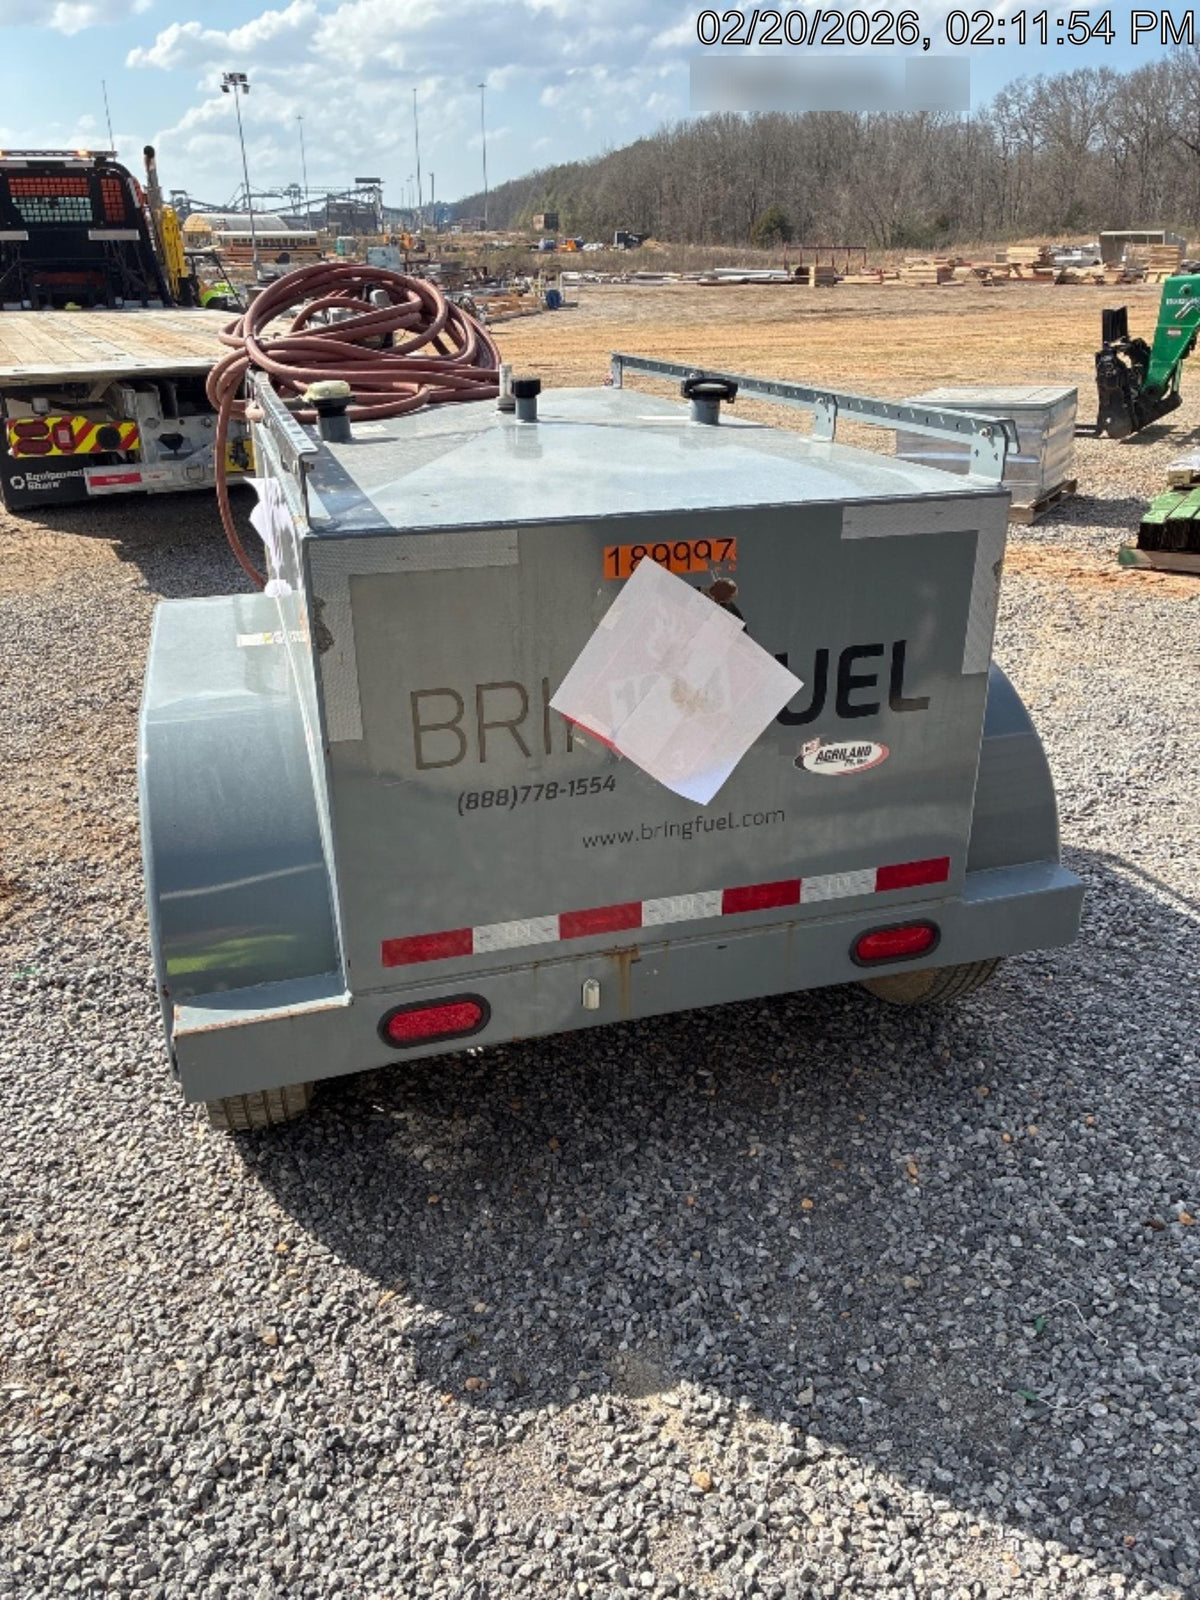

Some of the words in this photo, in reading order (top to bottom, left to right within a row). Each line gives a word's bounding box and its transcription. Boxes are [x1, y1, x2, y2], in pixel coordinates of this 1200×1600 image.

[608, 538, 734, 577] 189997
[814, 744, 872, 764] AGRILAND
[457, 775, 616, 816] (888)778-1554
[582, 809, 785, 848] www.bringfuel.com
